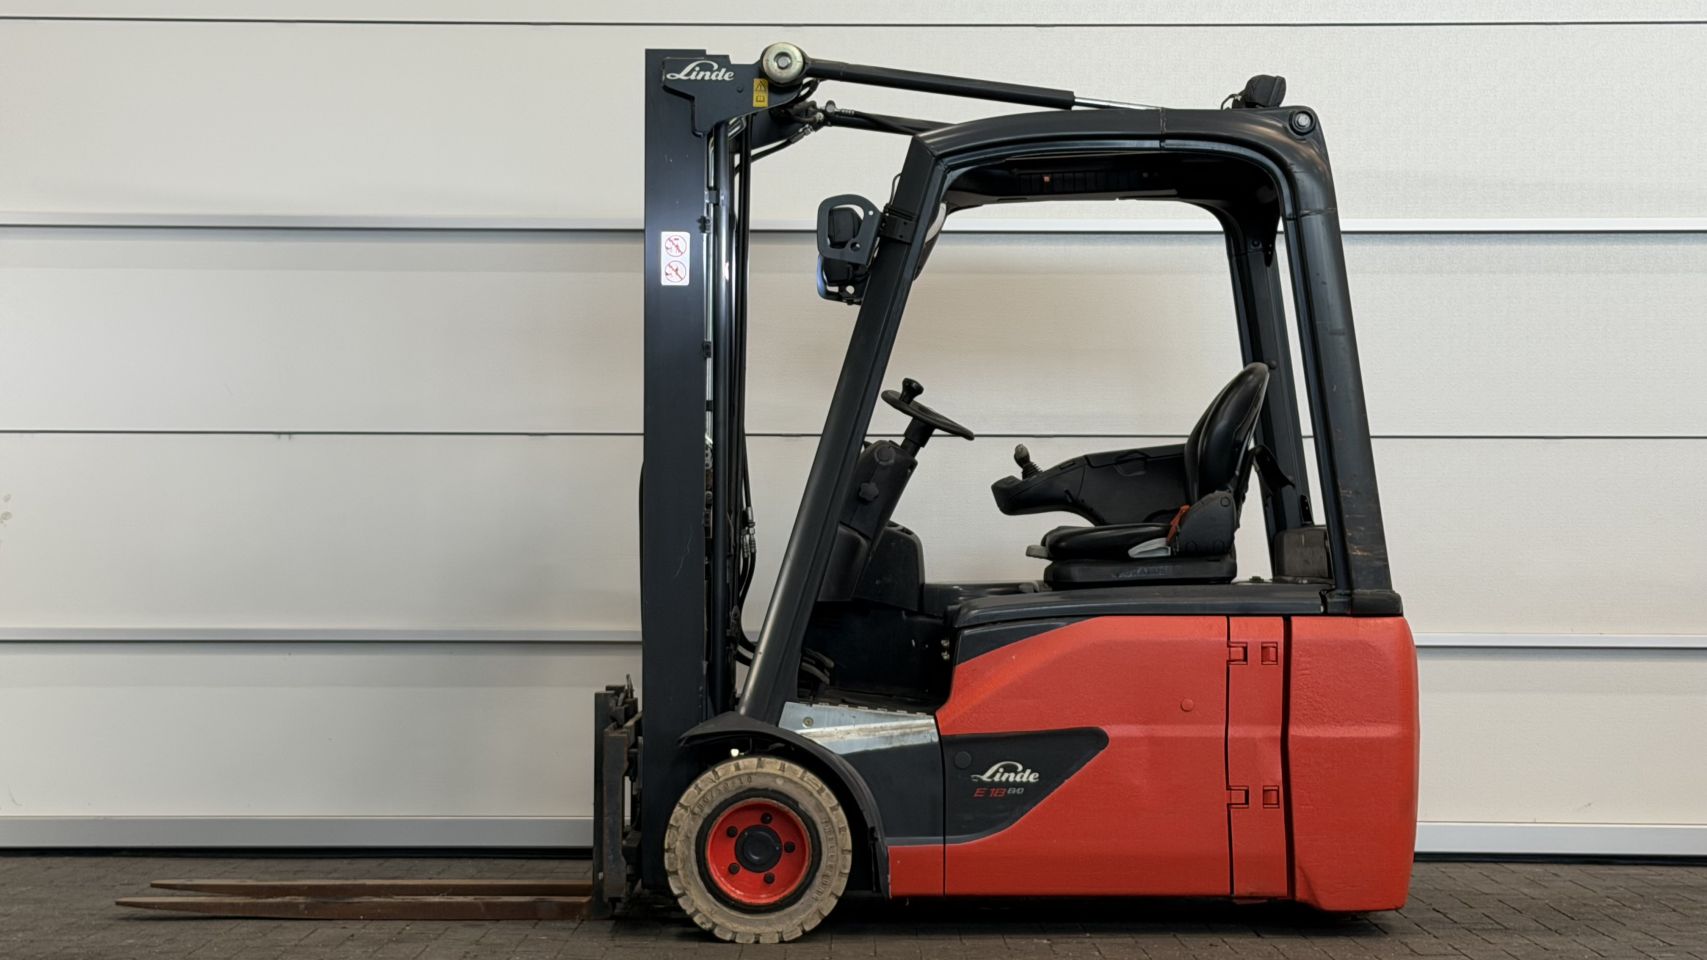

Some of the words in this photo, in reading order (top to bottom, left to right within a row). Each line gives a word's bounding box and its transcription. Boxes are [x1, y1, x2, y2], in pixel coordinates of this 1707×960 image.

[666, 60, 735, 81] Linde
[970, 760, 1040, 783] Linde
[973, 787, 988, 798] E
